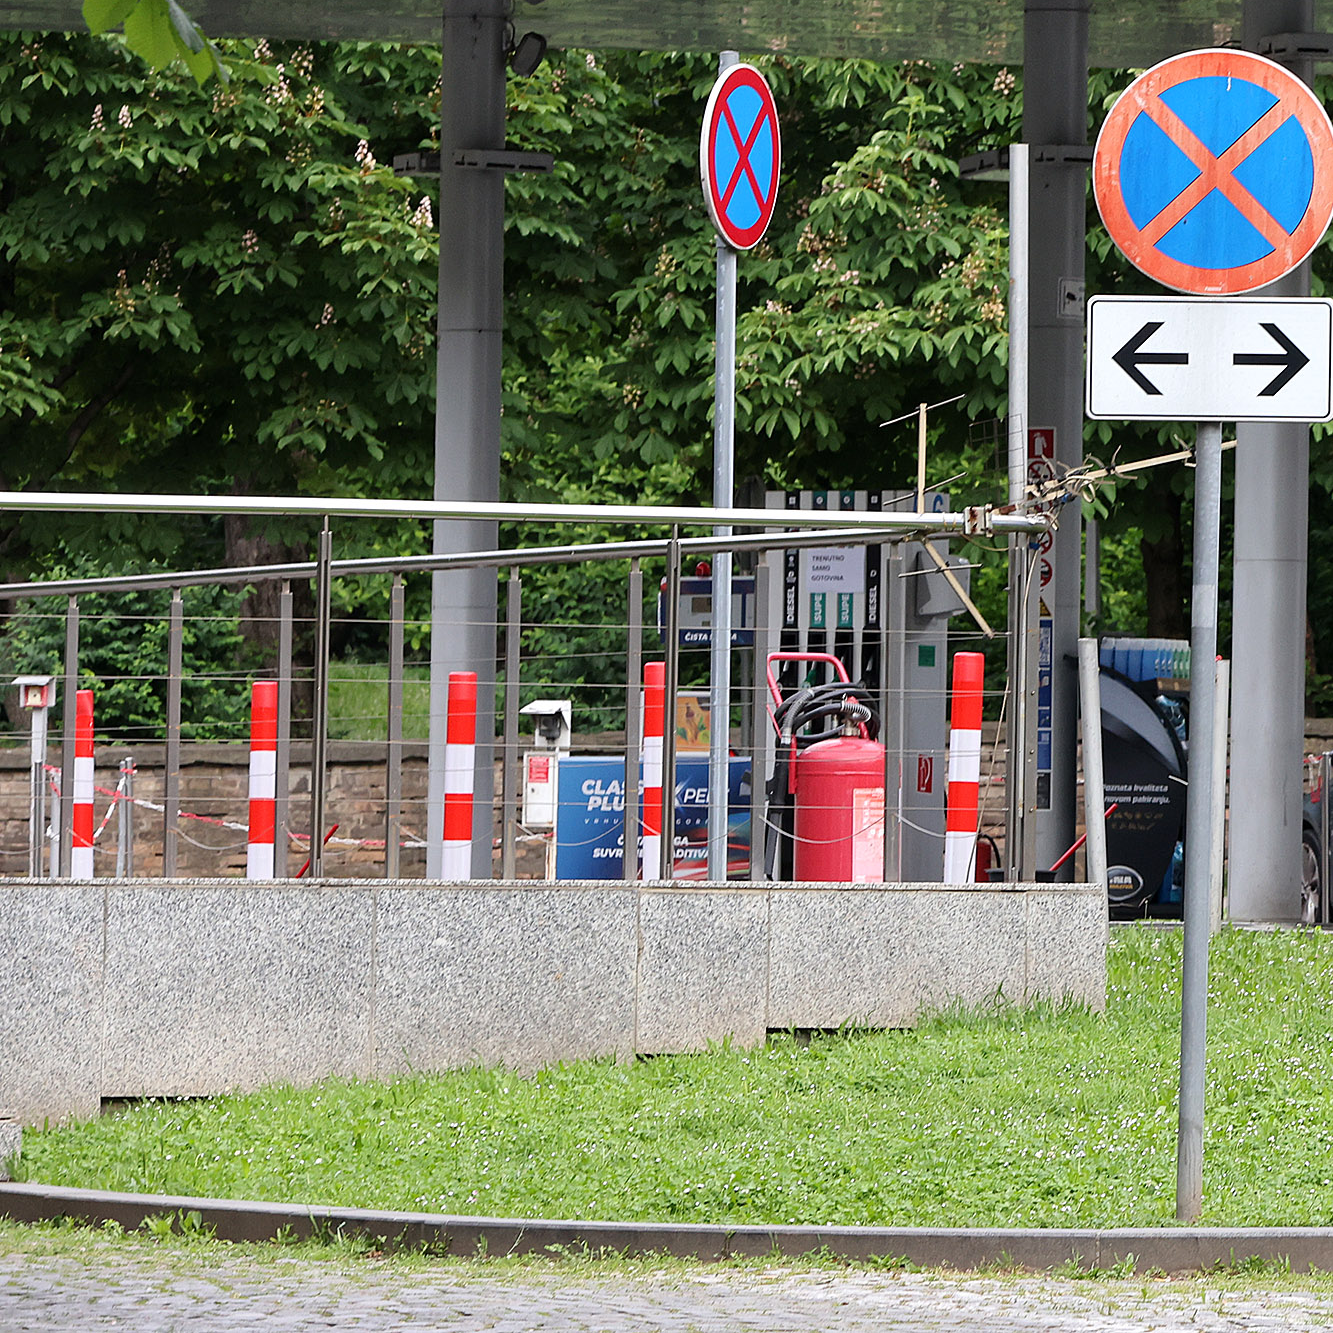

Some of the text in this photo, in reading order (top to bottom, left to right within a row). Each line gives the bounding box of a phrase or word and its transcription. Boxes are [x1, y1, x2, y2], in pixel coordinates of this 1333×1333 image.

[814, 593, 823, 622] SUPE
[842, 593, 850, 622] SUPE
[586, 795, 626, 812] PLU
